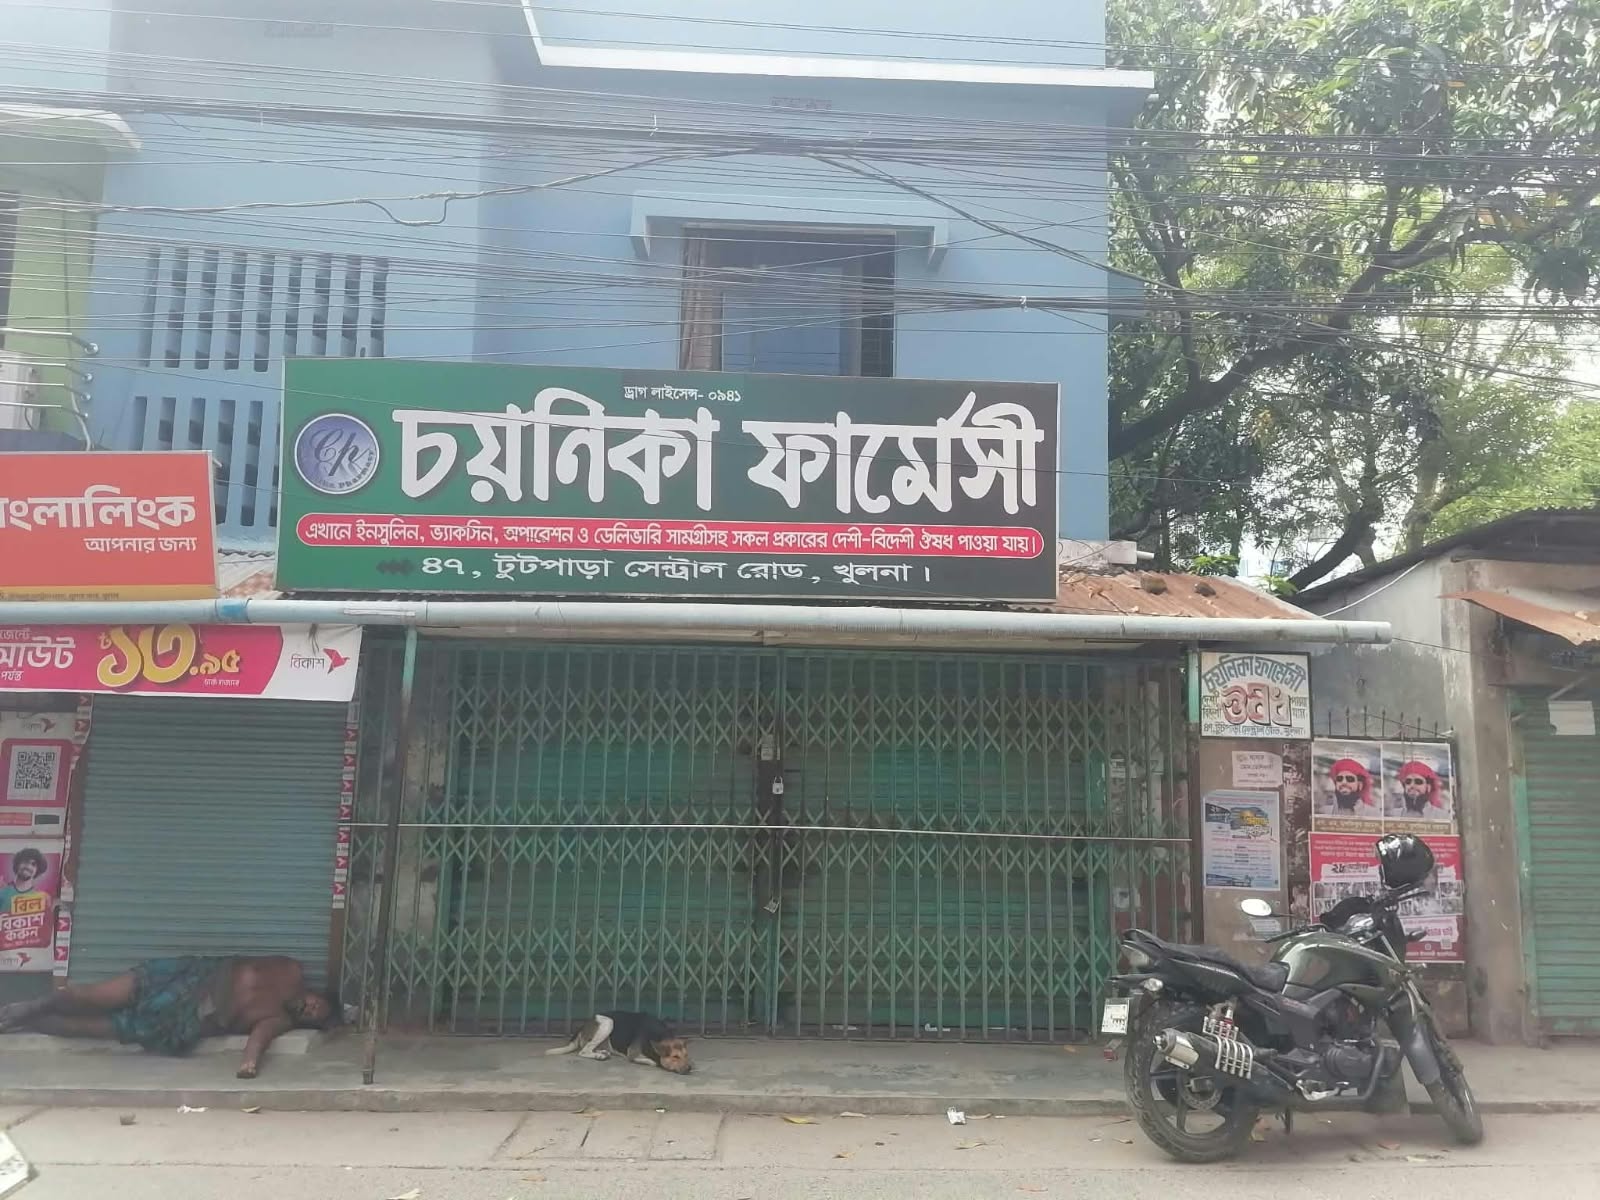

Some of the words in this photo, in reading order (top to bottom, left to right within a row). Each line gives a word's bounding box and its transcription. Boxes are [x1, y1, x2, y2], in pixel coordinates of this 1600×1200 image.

[708, 389, 742, 402] ০৯৪১
[391, 387, 721, 511] চয়নিকা
[741, 391, 1045, 514] ফার্মেসী
[84, 536, 155, 553] আপনার
[158, 536, 198, 552] জন্য
[305, 521, 353, 541] এখানে
[355, 518, 425, 545] ইনসুলিন,
[428, 519, 499, 544] ভ্যাকসিন,
[503, 525, 574, 544] অপারেশন
[577, 527, 590, 544] ও
[594, 521, 662, 545] ডেলিভারি
[665, 523, 729, 548] সামগ্রীসহ
[731, 529, 769, 547] সকল
[772, 531, 828, 549] প্রকারের
[832, 526, 915, 550] দেশী-বিদেশী
[919, 527, 953, 551] ঔষধ
[957, 534, 998, 552] পাওয়া
[491, 552, 616, 582] টুটপাড়া
[624, 555, 728, 581] সেন্ট্রাল
[290, 653, 325, 670] বিকাশ
[1202, 655, 1254, 692] চয়নিকা
[14, 897, 42, 913] বিল
